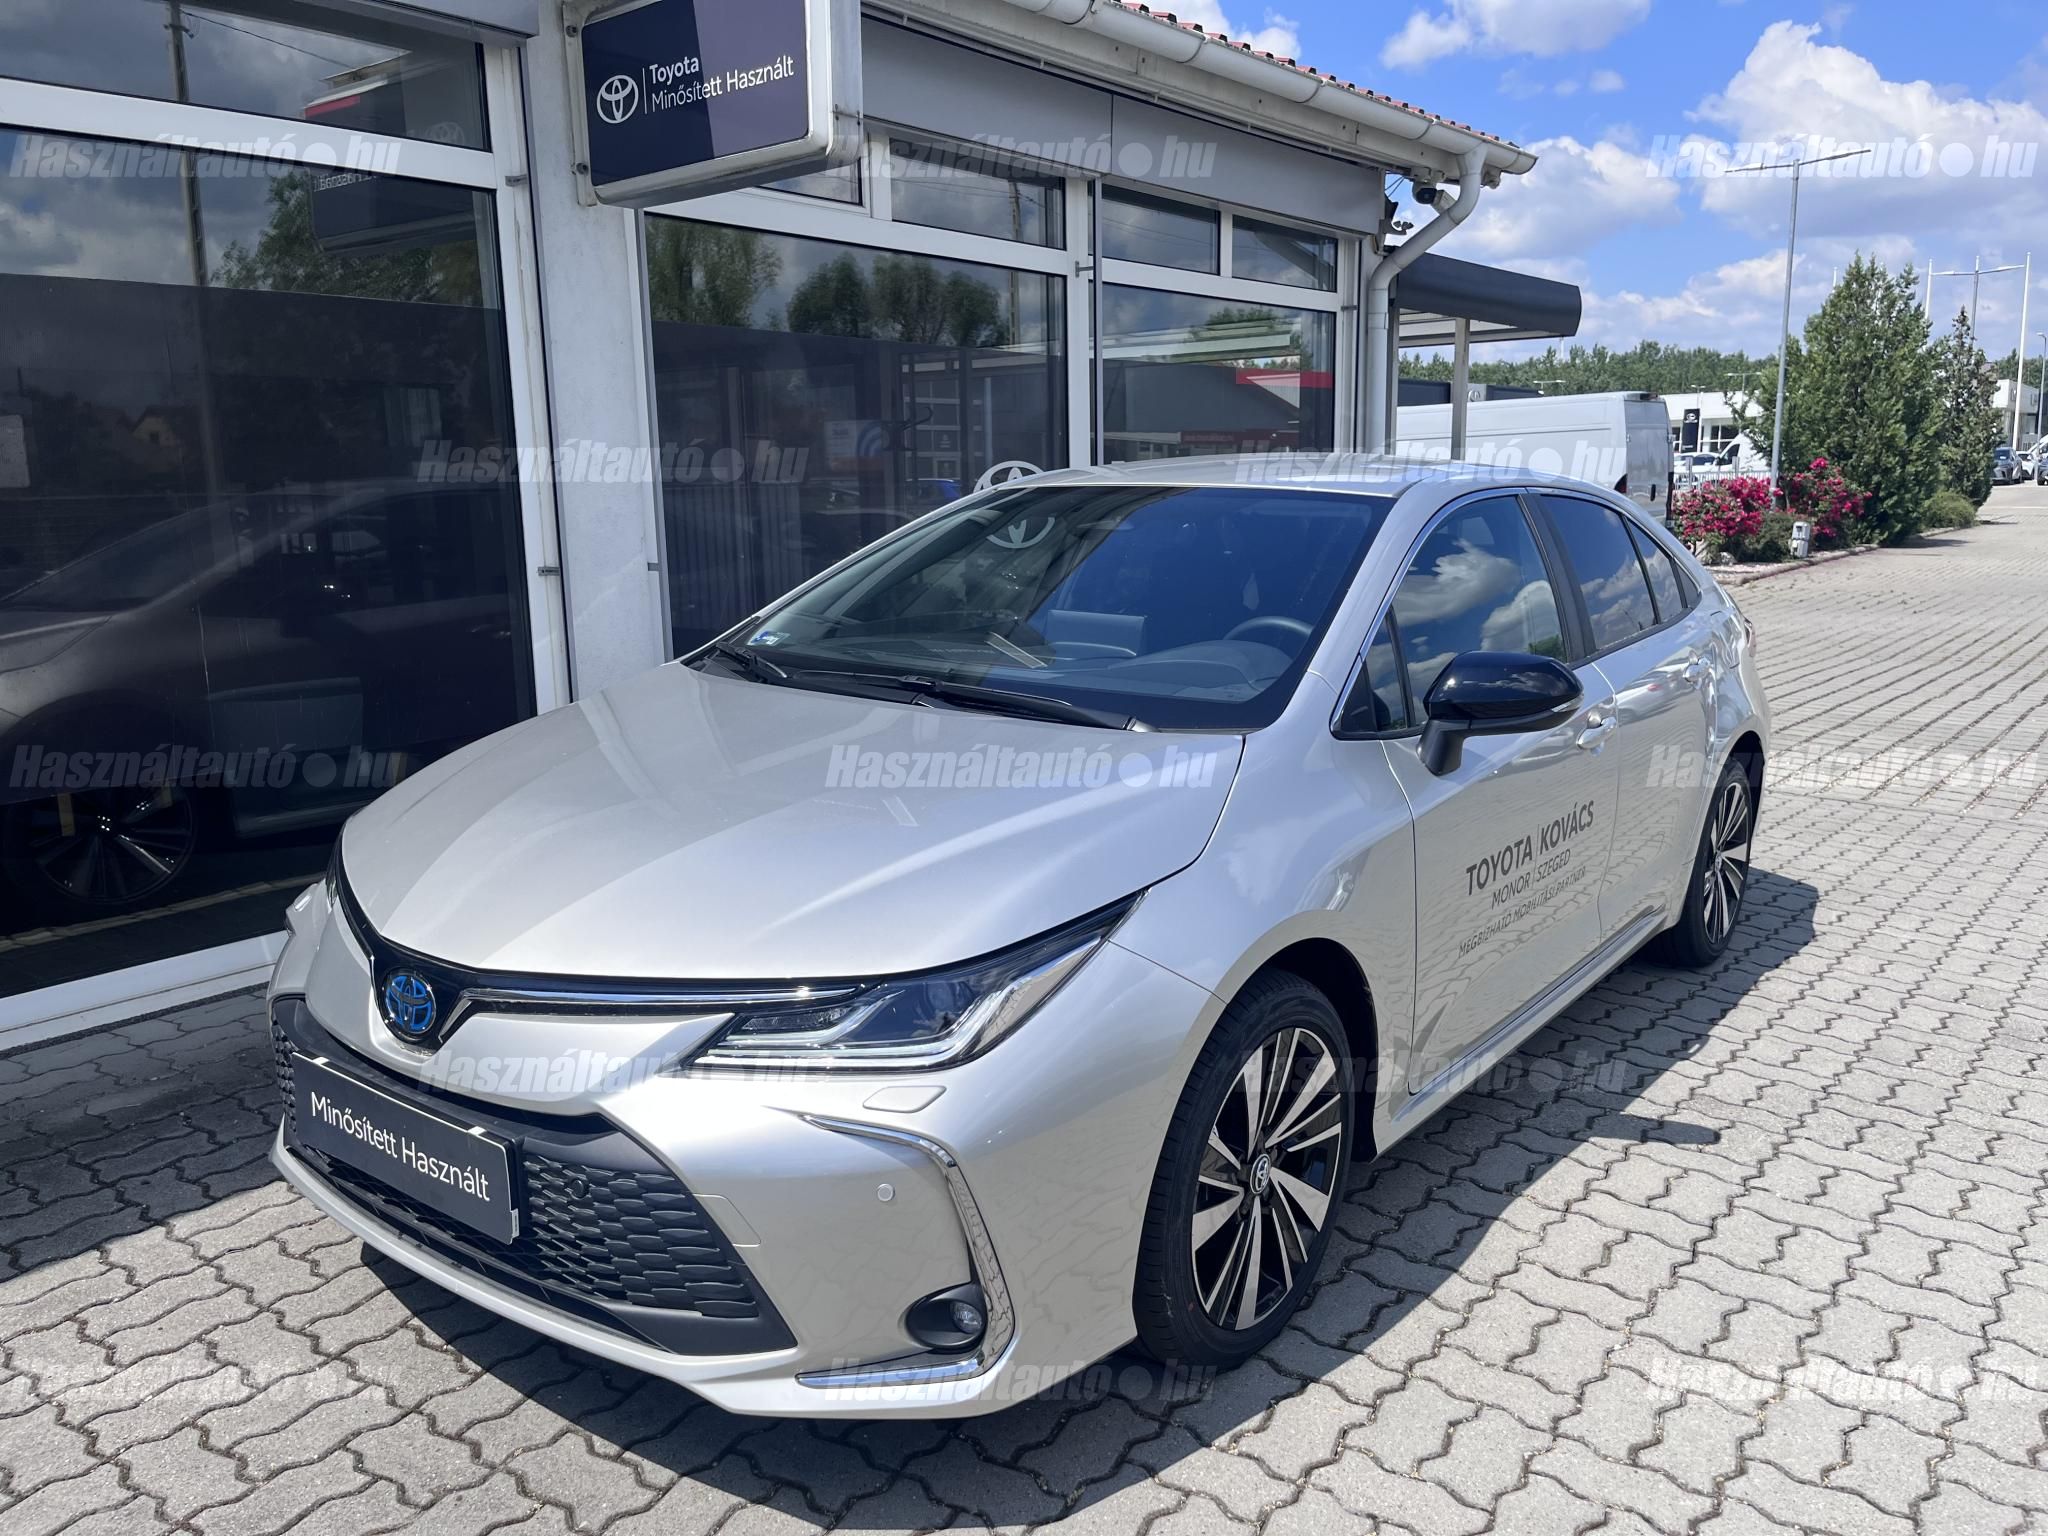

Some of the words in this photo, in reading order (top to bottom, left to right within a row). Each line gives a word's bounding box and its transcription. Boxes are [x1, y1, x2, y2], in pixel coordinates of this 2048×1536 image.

[649, 56, 699, 86] Toyota
[652, 76, 723, 113] Minősített
[726, 55, 795, 92] Használt
[1466, 835, 1533, 896] TOYOTA
[1539, 800, 1594, 855] KOVÁCS
[1491, 871, 1531, 910] MONOR
[1536, 848, 1571, 883] SZEGED
[310, 1091, 398, 1159] Minősített
[401, 1136, 490, 1203] Használt
